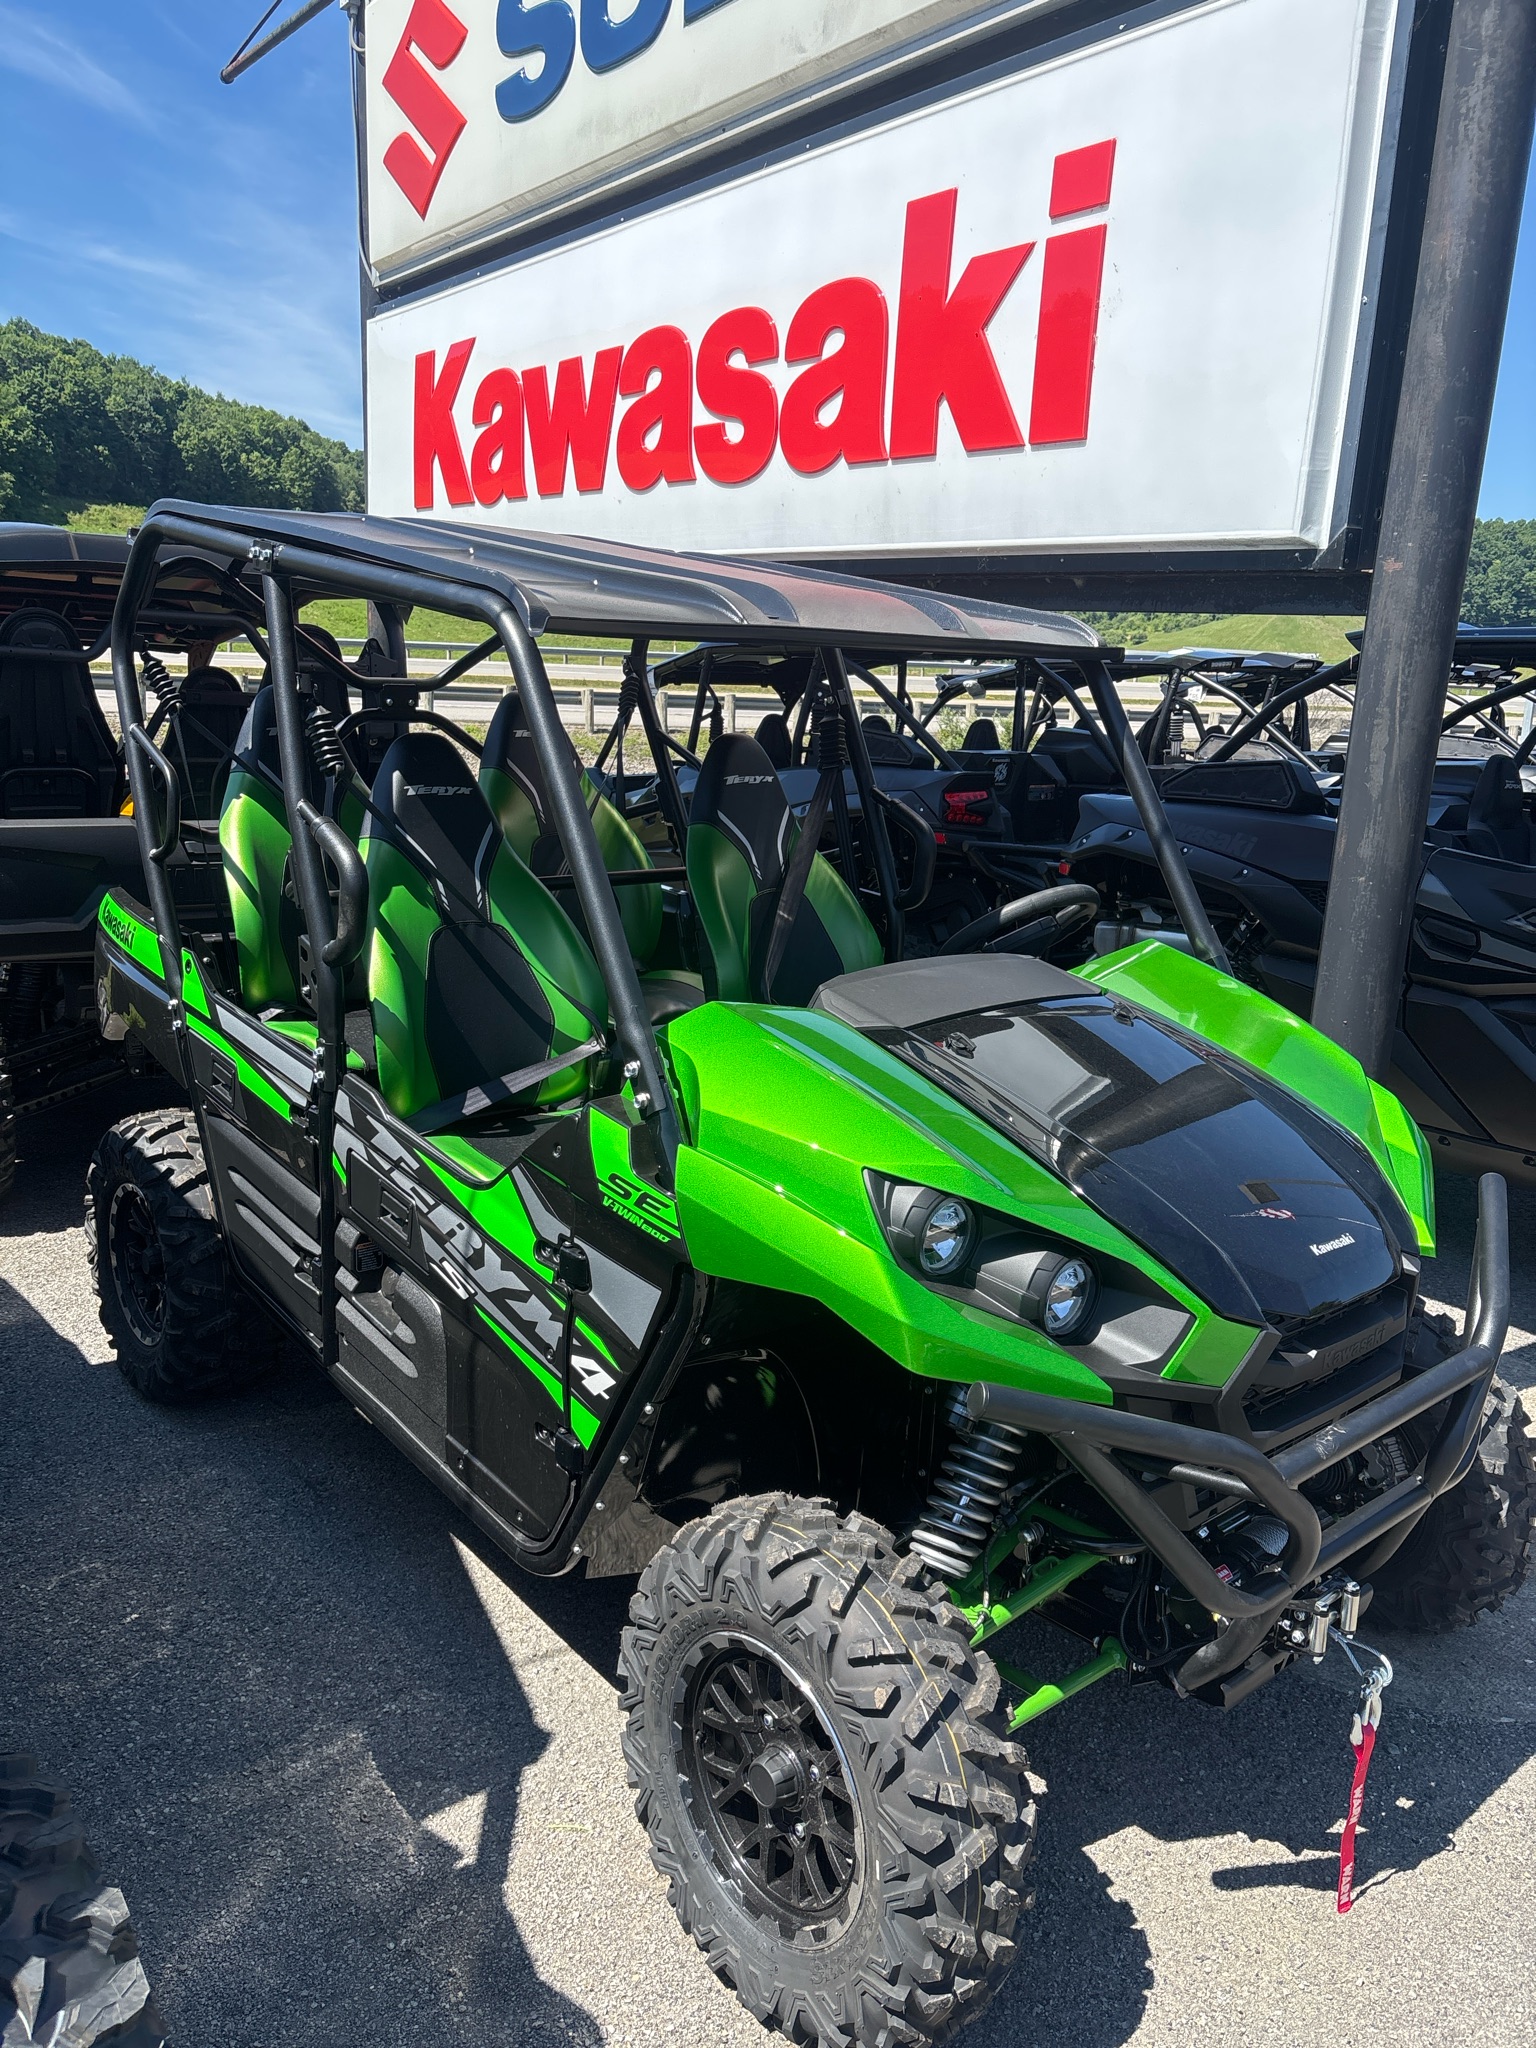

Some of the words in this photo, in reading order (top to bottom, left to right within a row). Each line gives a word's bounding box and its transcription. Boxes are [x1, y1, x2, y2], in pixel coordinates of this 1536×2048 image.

[413, 138, 1117, 511] Kawasaki
[102, 899, 138, 950] Kawasaki
[1309, 1232, 1356, 1257] Kawasaki
[1321, 1323, 1386, 1371] Kawasaki
